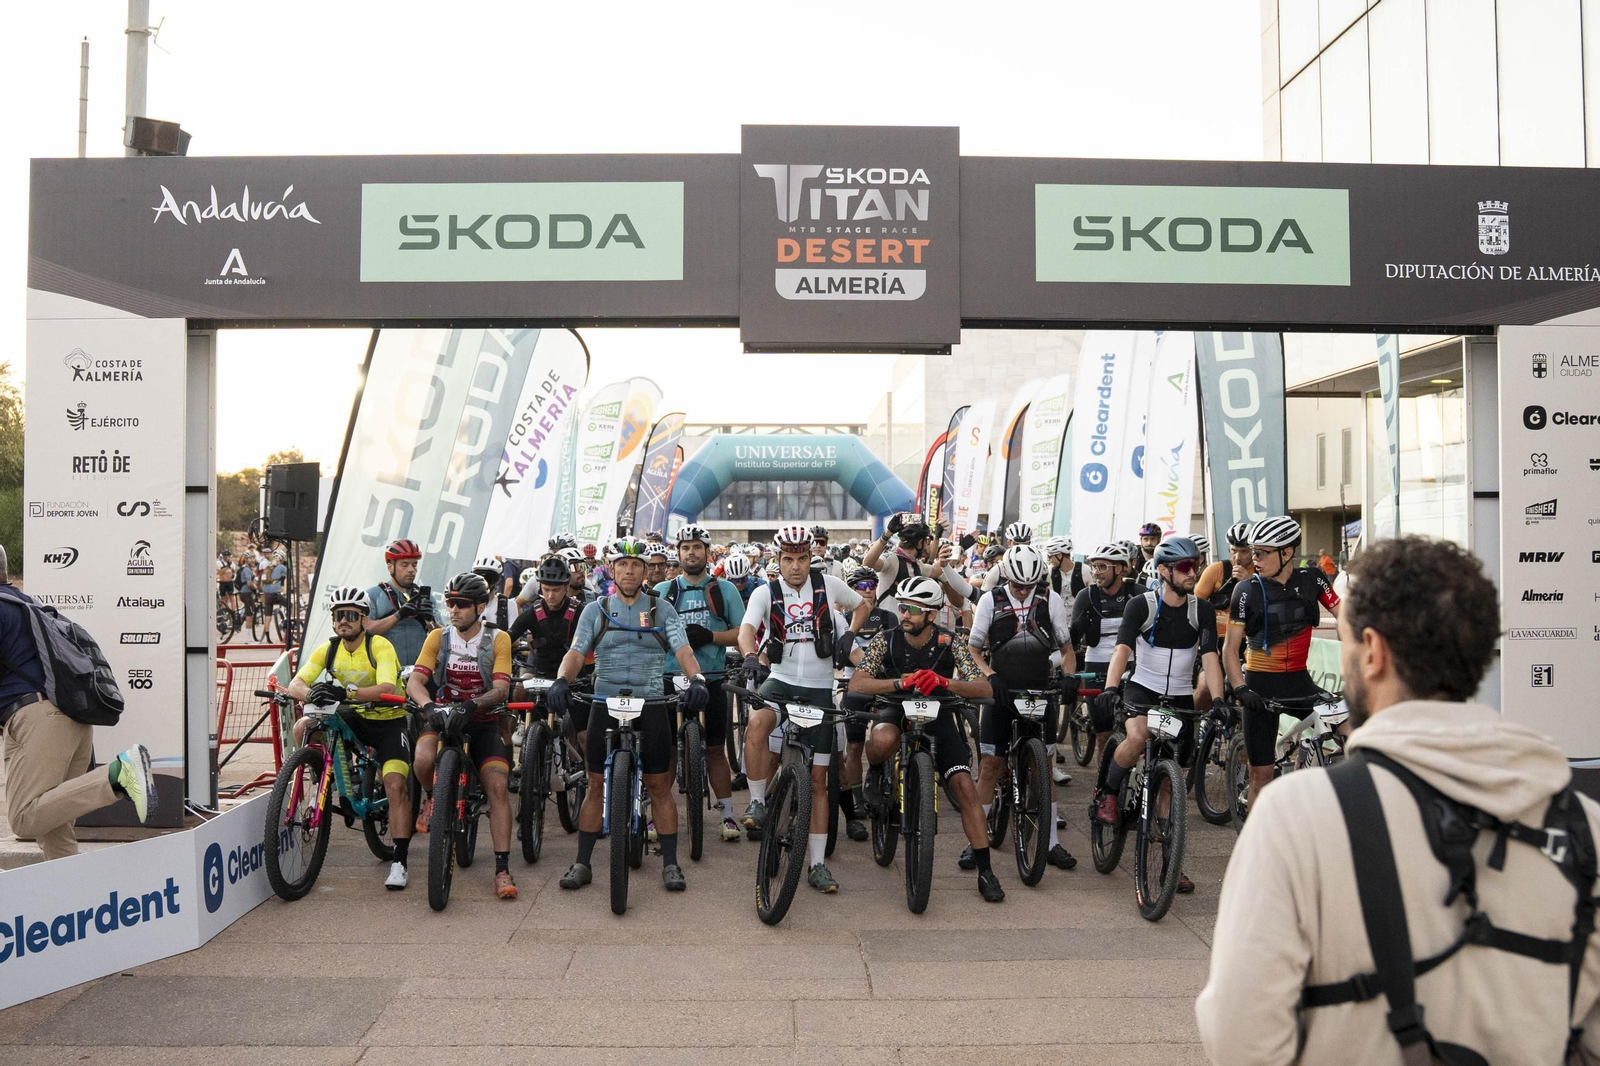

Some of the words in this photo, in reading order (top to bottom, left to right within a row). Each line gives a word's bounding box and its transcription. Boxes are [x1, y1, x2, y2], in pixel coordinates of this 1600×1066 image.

[826, 168, 931, 184] SKODA
[753, 164, 930, 222] TITAN
[152, 184, 321, 225] Andalucía
[398, 214, 645, 251] SKODA
[827, 226, 871, 234] STAGE
[1073, 215, 1314, 254] SKODA
[777, 238, 930, 263] DESERT
[1385, 262, 1494, 280] DIPUTACIÓN
[1499, 266, 1522, 280] DE
[1526, 264, 1600, 282] ALMERÍA
[233, 277, 266, 285] Andalucía
[795, 272, 906, 295] ALMERÍA
[95, 359, 128, 368] COSTA
[129, 359, 142, 368] DE
[85, 369, 143, 382] ALMERÍA
[1560, 369, 1593, 377] CIUDAD
[508, 395, 546, 446] COSTA
[541, 369, 561, 395] DE
[1090, 352, 1116, 456] Cleardent
[91, 415, 139, 427] EJÉRCITO
[513, 382, 577, 478] ALMERÍA
[735, 445, 836, 459] UNIVERSAE
[73, 450, 107, 473] RETO
[113, 450, 130, 473] DE
[735, 460, 770, 468] Instituto
[772, 460, 810, 469] Superior
[811, 460, 823, 468] de
[1523, 467, 1558, 477] primaflor
[46, 500, 89, 509] FUNDACIÓN
[1525, 501, 1555, 514] FINISHER
[1519, 552, 1565, 563] MRW
[1521, 589, 1564, 602] Almería
[122, 634, 142, 643] SOLO
[143, 632, 158, 643] BICI
[1511, 630, 1522, 638] LA
[1522, 630, 1575, 638] VANGUARDIA
[128, 669, 153, 678] SER
[1534, 666, 1543, 685] RAC
[128, 679, 153, 689] 100
[620, 698, 631, 706] 51
[914, 701, 928, 709] 96
[1025, 700, 1036, 709] 93
[799, 706, 811, 714] 89
[1160, 715, 1171, 726] 94
